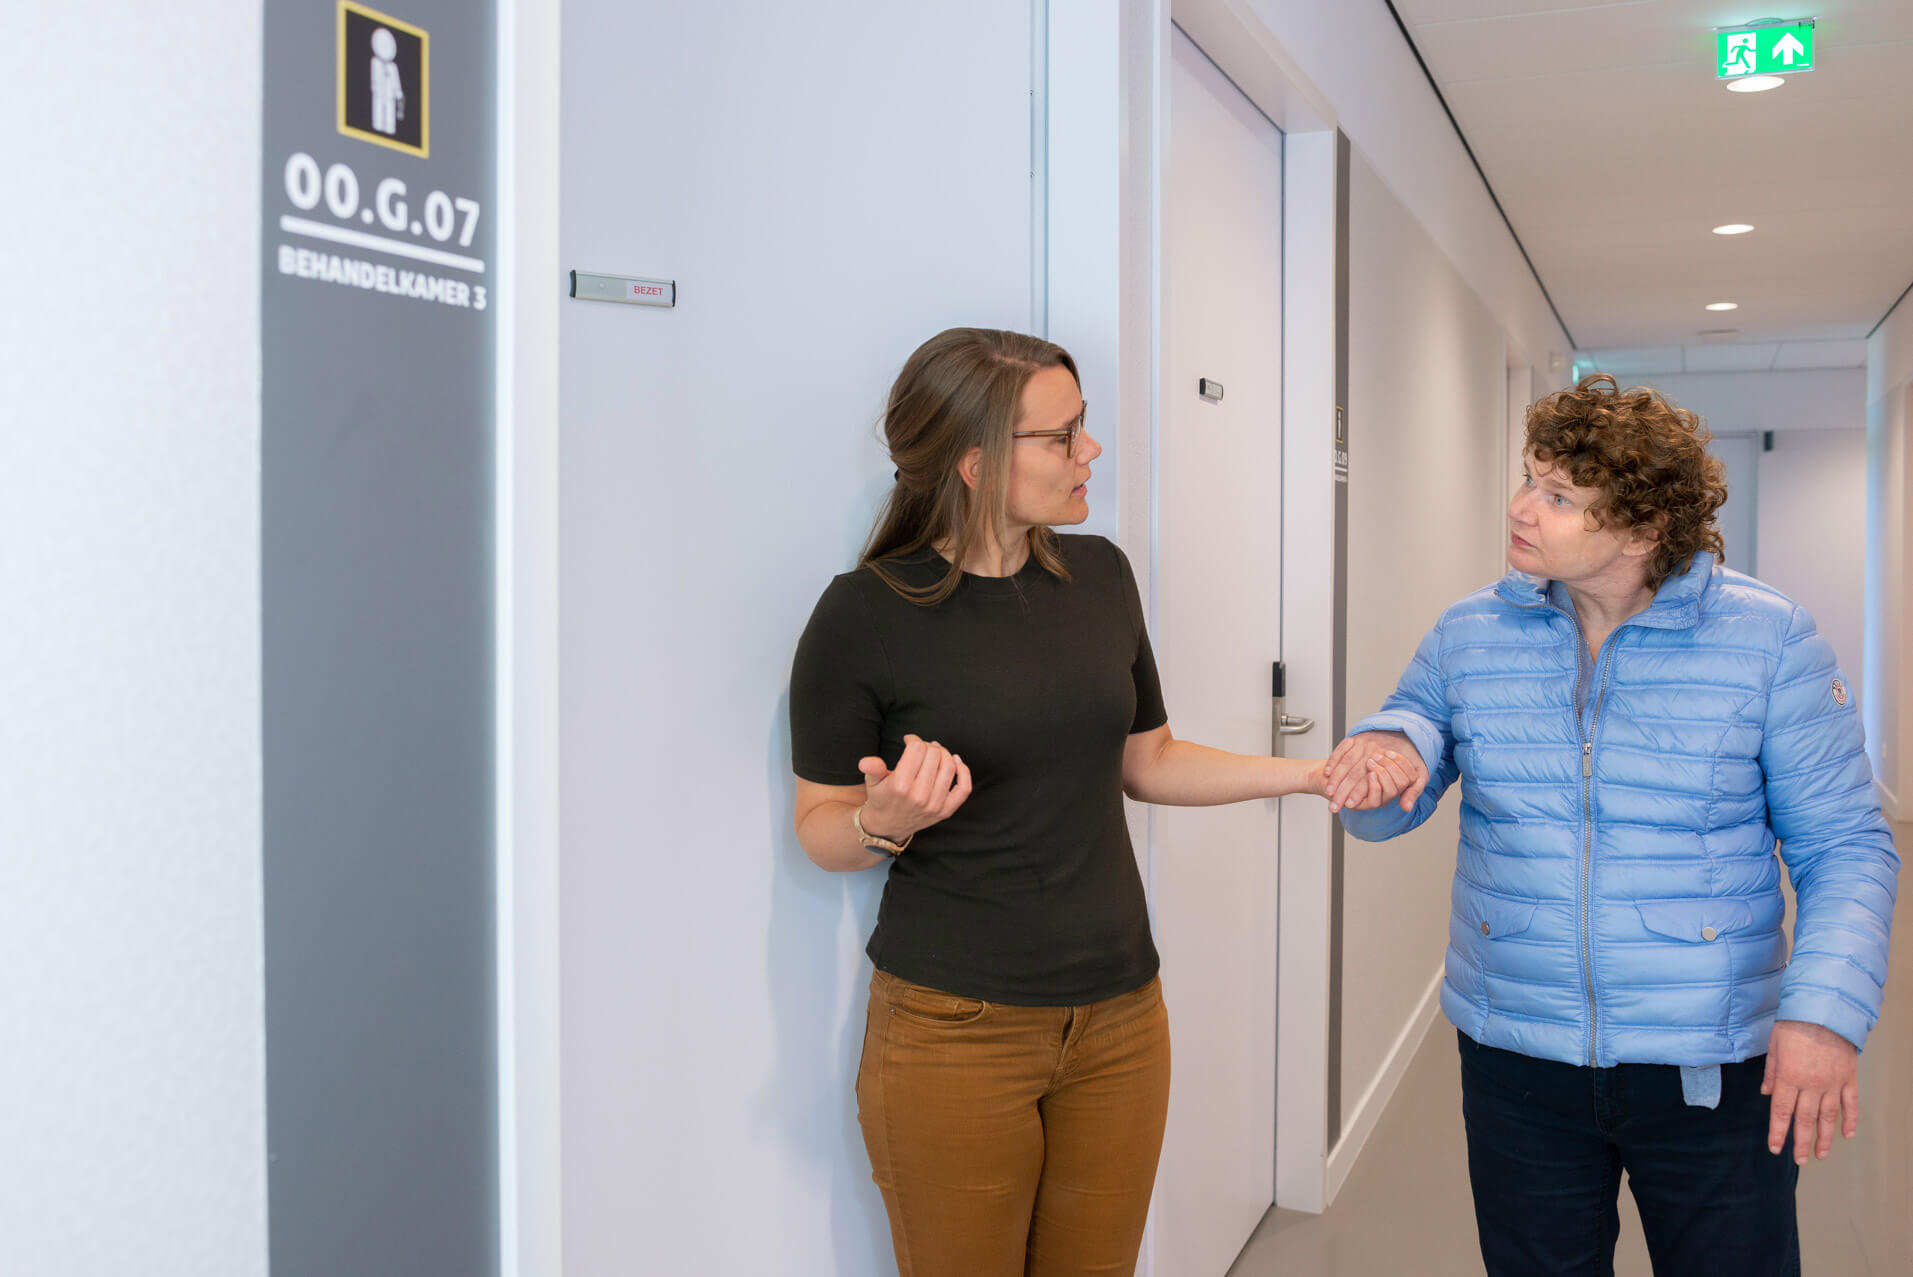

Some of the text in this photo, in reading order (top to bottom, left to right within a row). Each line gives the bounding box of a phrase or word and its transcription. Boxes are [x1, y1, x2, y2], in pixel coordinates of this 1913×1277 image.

[284, 152, 480, 247] 00.G.07
[278, 245, 487, 311] BEHANDELKAMER 3
[633, 285, 664, 297] BEZET
